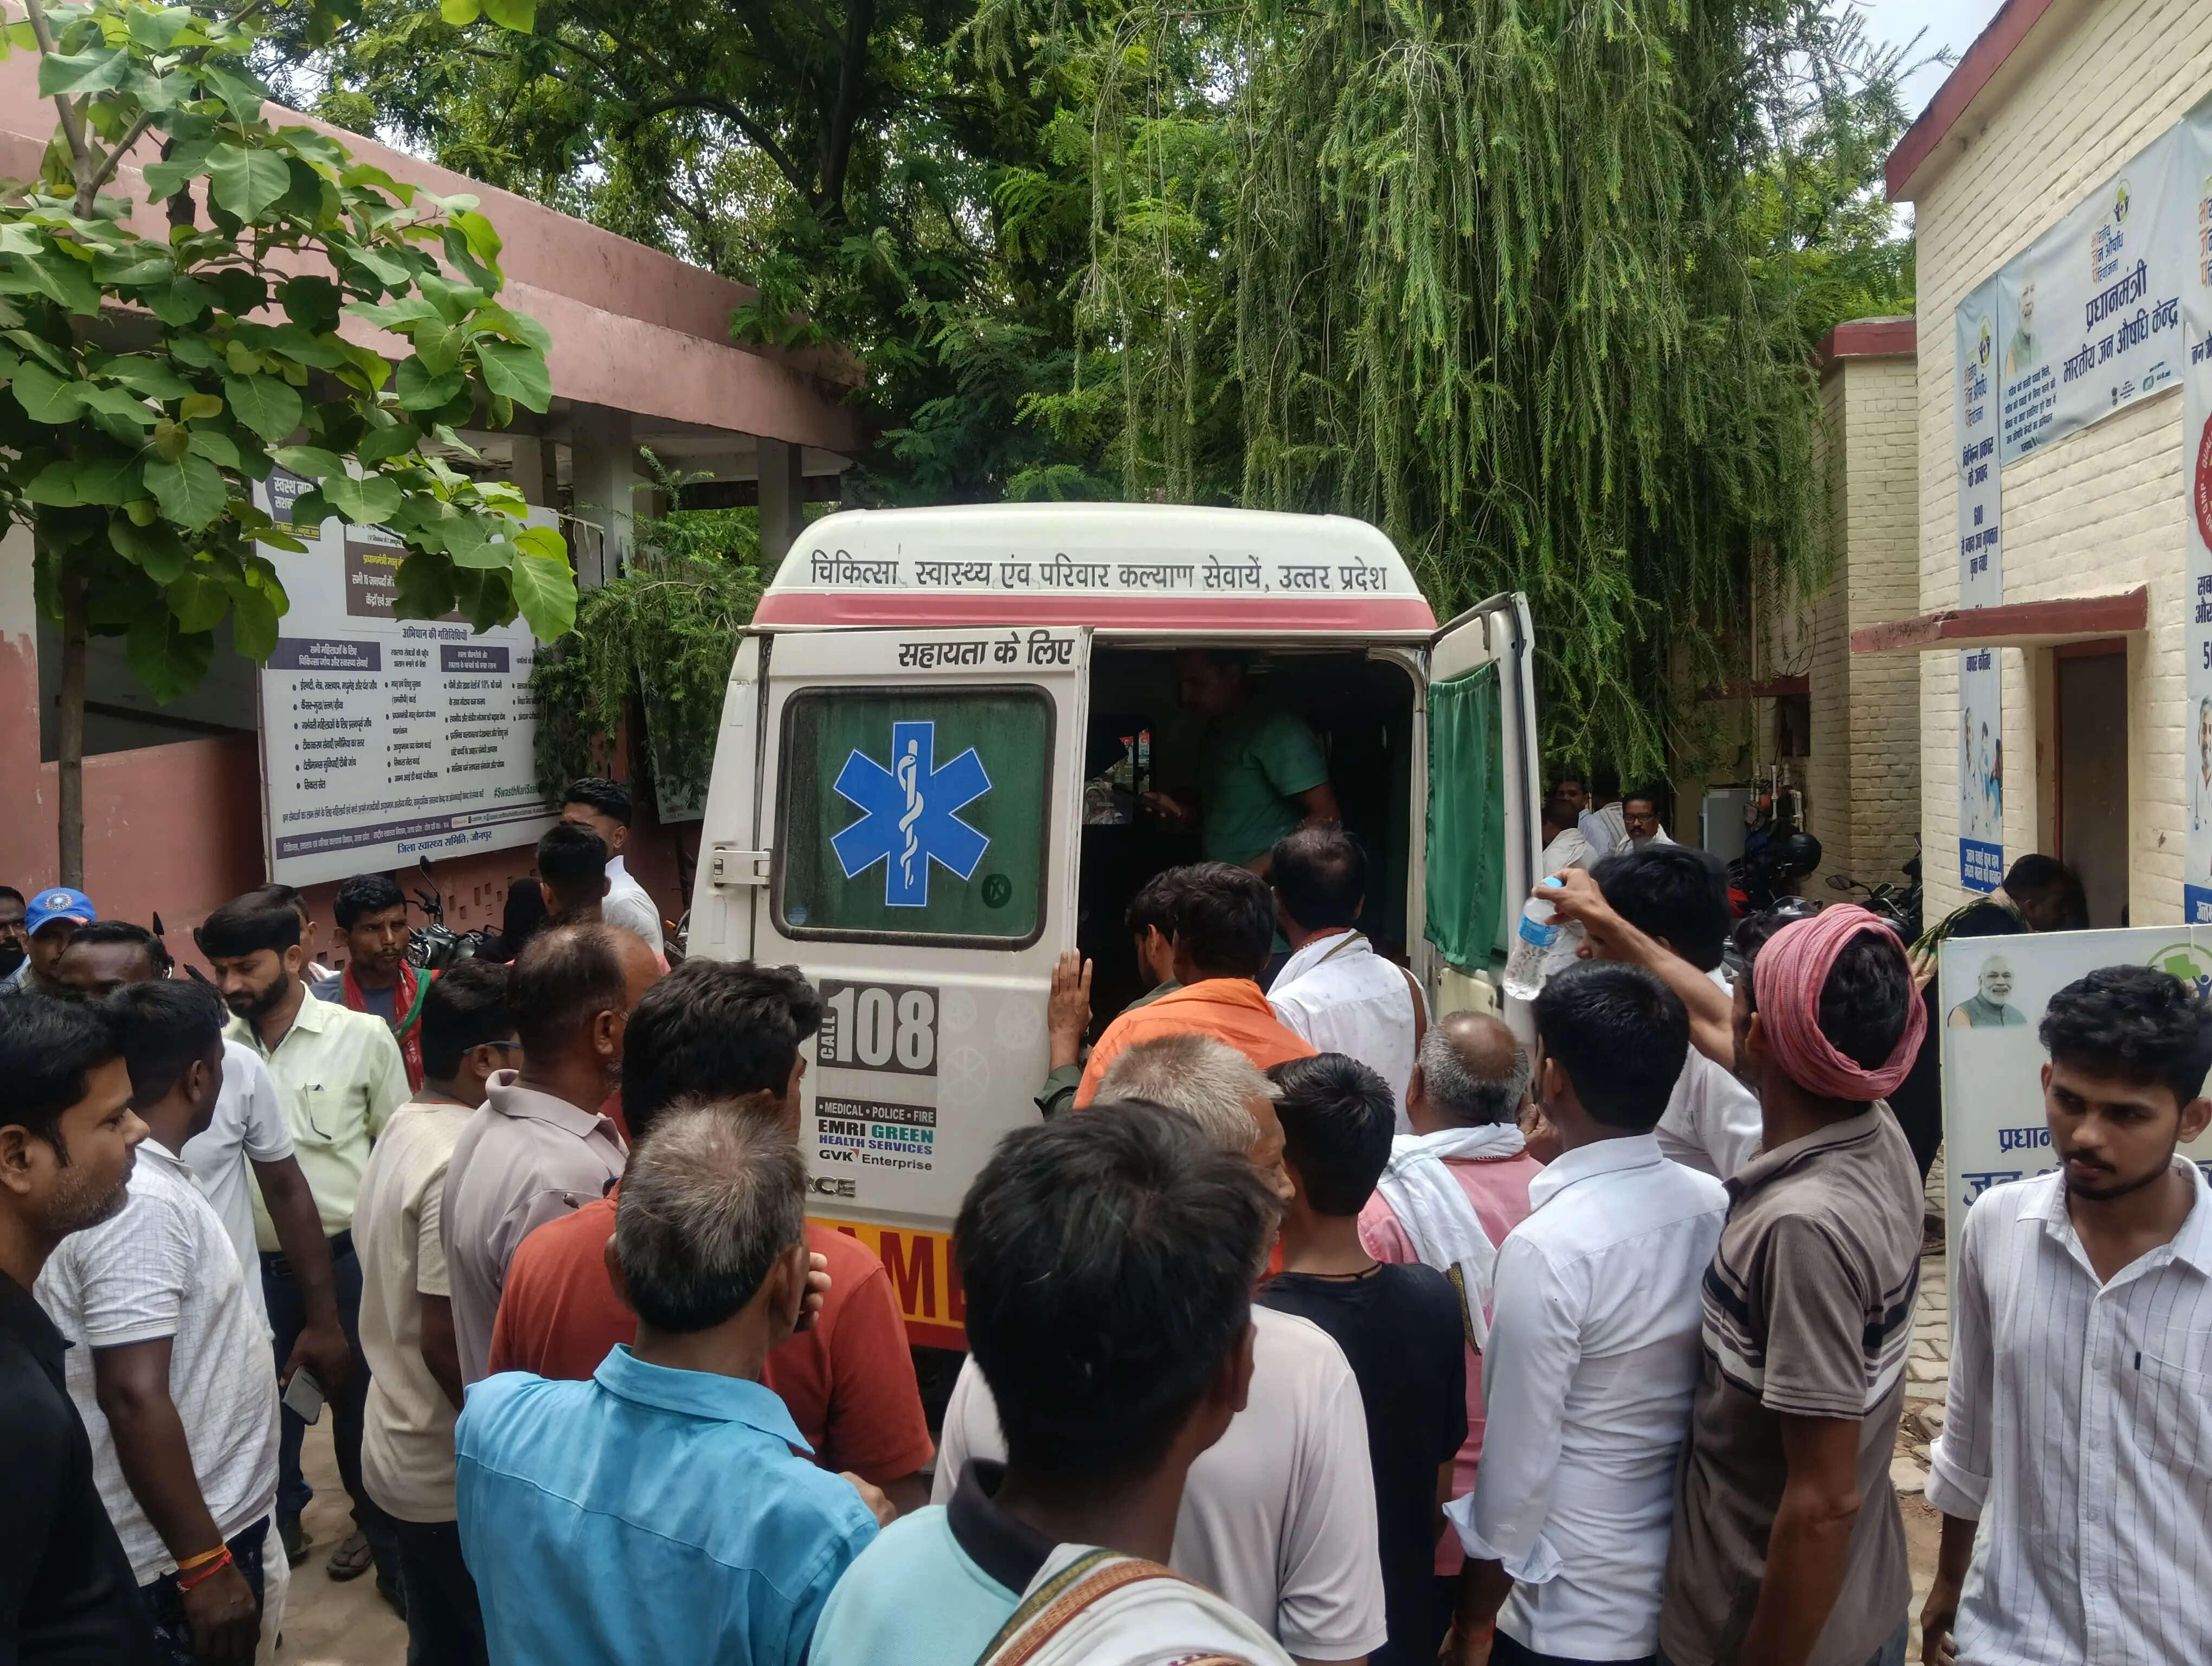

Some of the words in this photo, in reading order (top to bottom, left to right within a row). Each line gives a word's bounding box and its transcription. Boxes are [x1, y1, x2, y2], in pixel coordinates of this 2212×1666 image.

[2091, 247, 2104, 266] जन
[2106, 230, 2124, 258] औषधि
[2086, 259, 2147, 333] प्रधानमंत्री
[2064, 343, 2095, 383] भारतीय
[2098, 334, 2114, 364] जन
[2117, 308, 2149, 354] औषधि
[2152, 297, 2179, 330] केन्द्र
[2191, 343, 2203, 366] जन
[273, 477, 295, 495] स्वस्थ
[1968, 467, 1973, 488] के
[1975, 504, 1983, 526] 600
[352, 571, 363, 585] सभी
[811, 549, 899, 584] चिकित्सा
[915, 561, 992, 586] स्वास्थ्य
[1039, 553, 1110, 587] परिवार
[1118, 564, 1194, 588] कल्याण
[1202, 555, 1270, 593] सेवायें,
[1278, 565, 1331, 590] उत्तर
[1339, 556, 1387, 591] प्रदेश
[403, 626, 427, 639] अभियान
[429, 627, 436, 639] की
[343, 645, 347, 655] के
[899, 642, 988, 668] सहायता
[994, 631, 1021, 664] के
[1027, 629, 1075, 664] लिए
[2204, 642, 2212, 669] 5
[397, 843, 415, 854] जिला
[417, 839, 443, 850] स्वास्थ्य
[445, 835, 469, 846] समिति,
[471, 831, 492, 842] जौनपुर
[820, 1016, 835, 1059] CALL
[828, 987, 934, 1069] 108
[825, 1102, 864, 1116] MEDICAL
[872, 1106, 904, 1120] POLICE
[914, 1110, 934, 1123] FIRE
[819, 1119, 866, 1136] EMRI
[872, 1124, 933, 1143] GREEN
[819, 1135, 865, 1148] HEALTH
[869, 1139, 933, 1155] SERVICES
[819, 1149, 853, 1162] GVK
[863, 1154, 932, 1170] Enterprise
